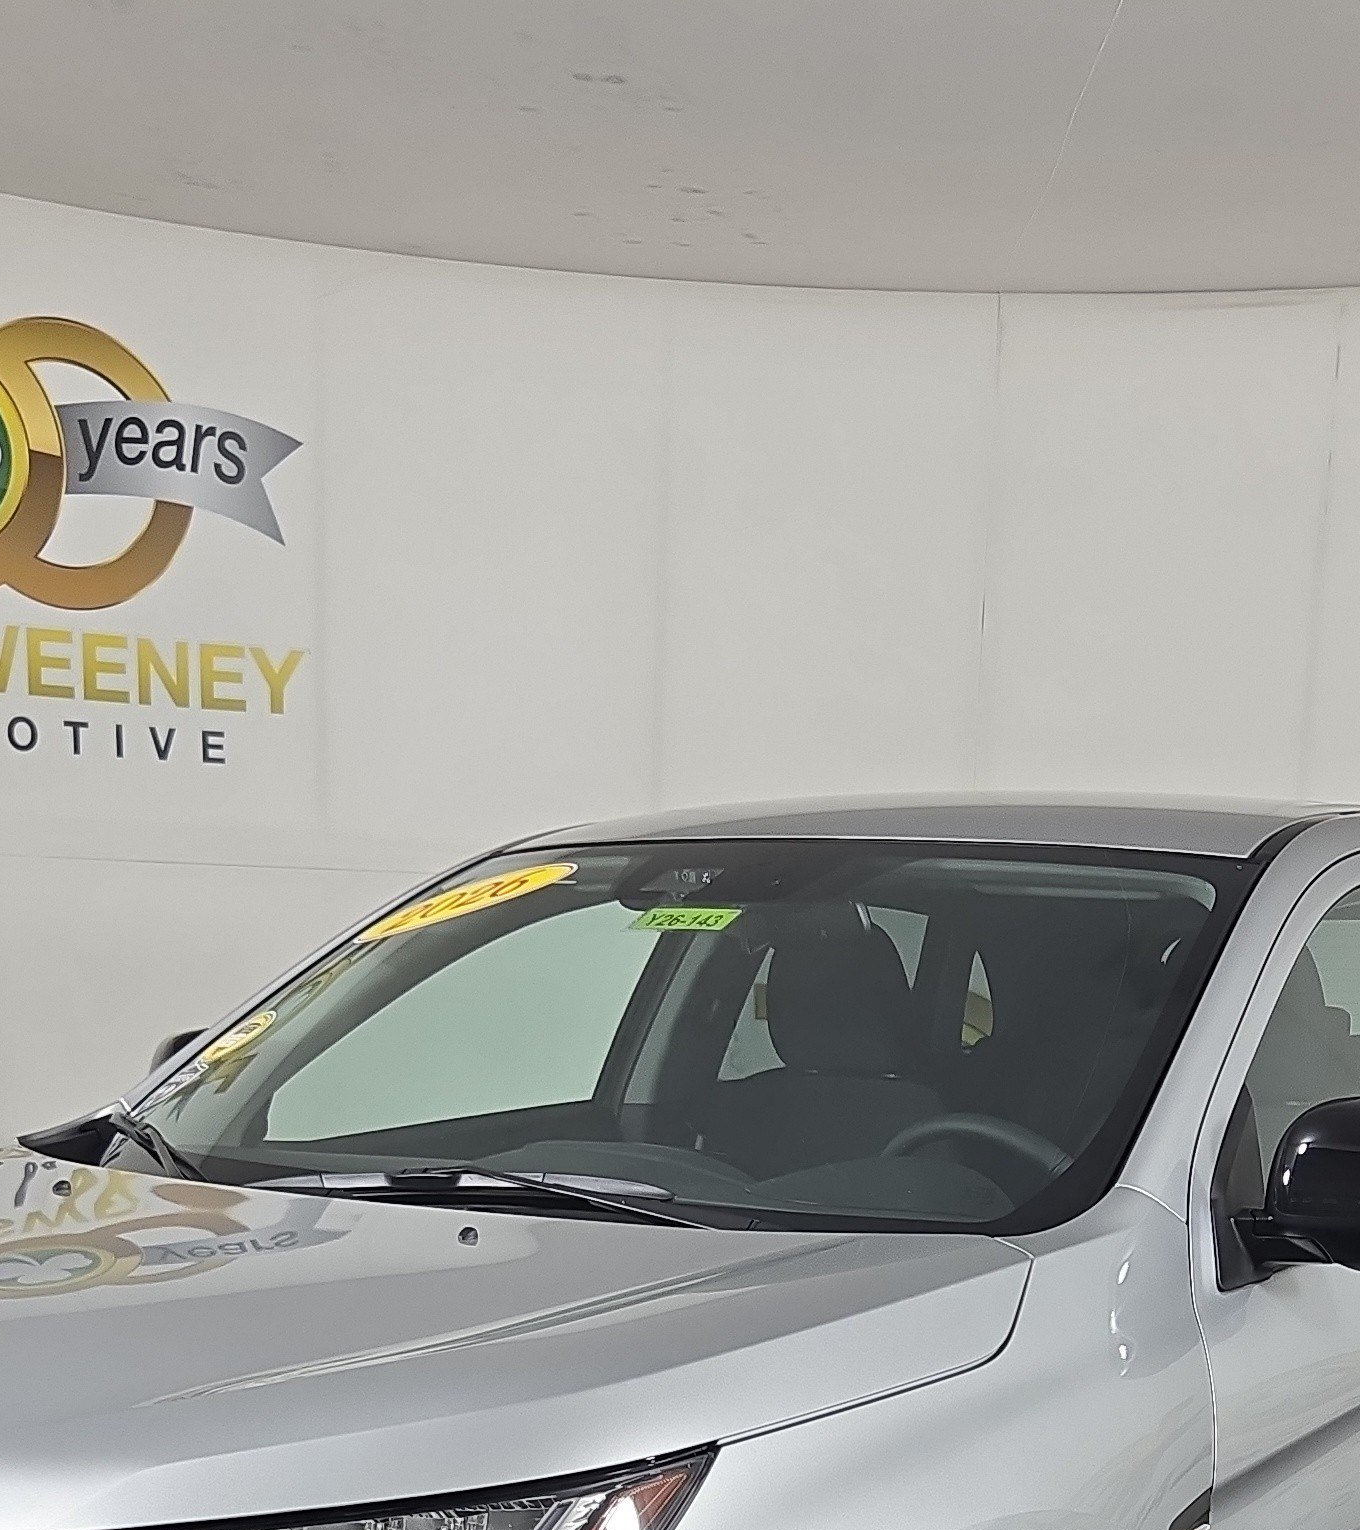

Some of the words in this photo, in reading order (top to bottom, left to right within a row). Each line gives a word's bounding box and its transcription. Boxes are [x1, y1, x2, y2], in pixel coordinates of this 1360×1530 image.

[77, 414, 249, 485] years
[379, 868, 547, 936] 2026
[644, 912, 724, 929] Y26-143
